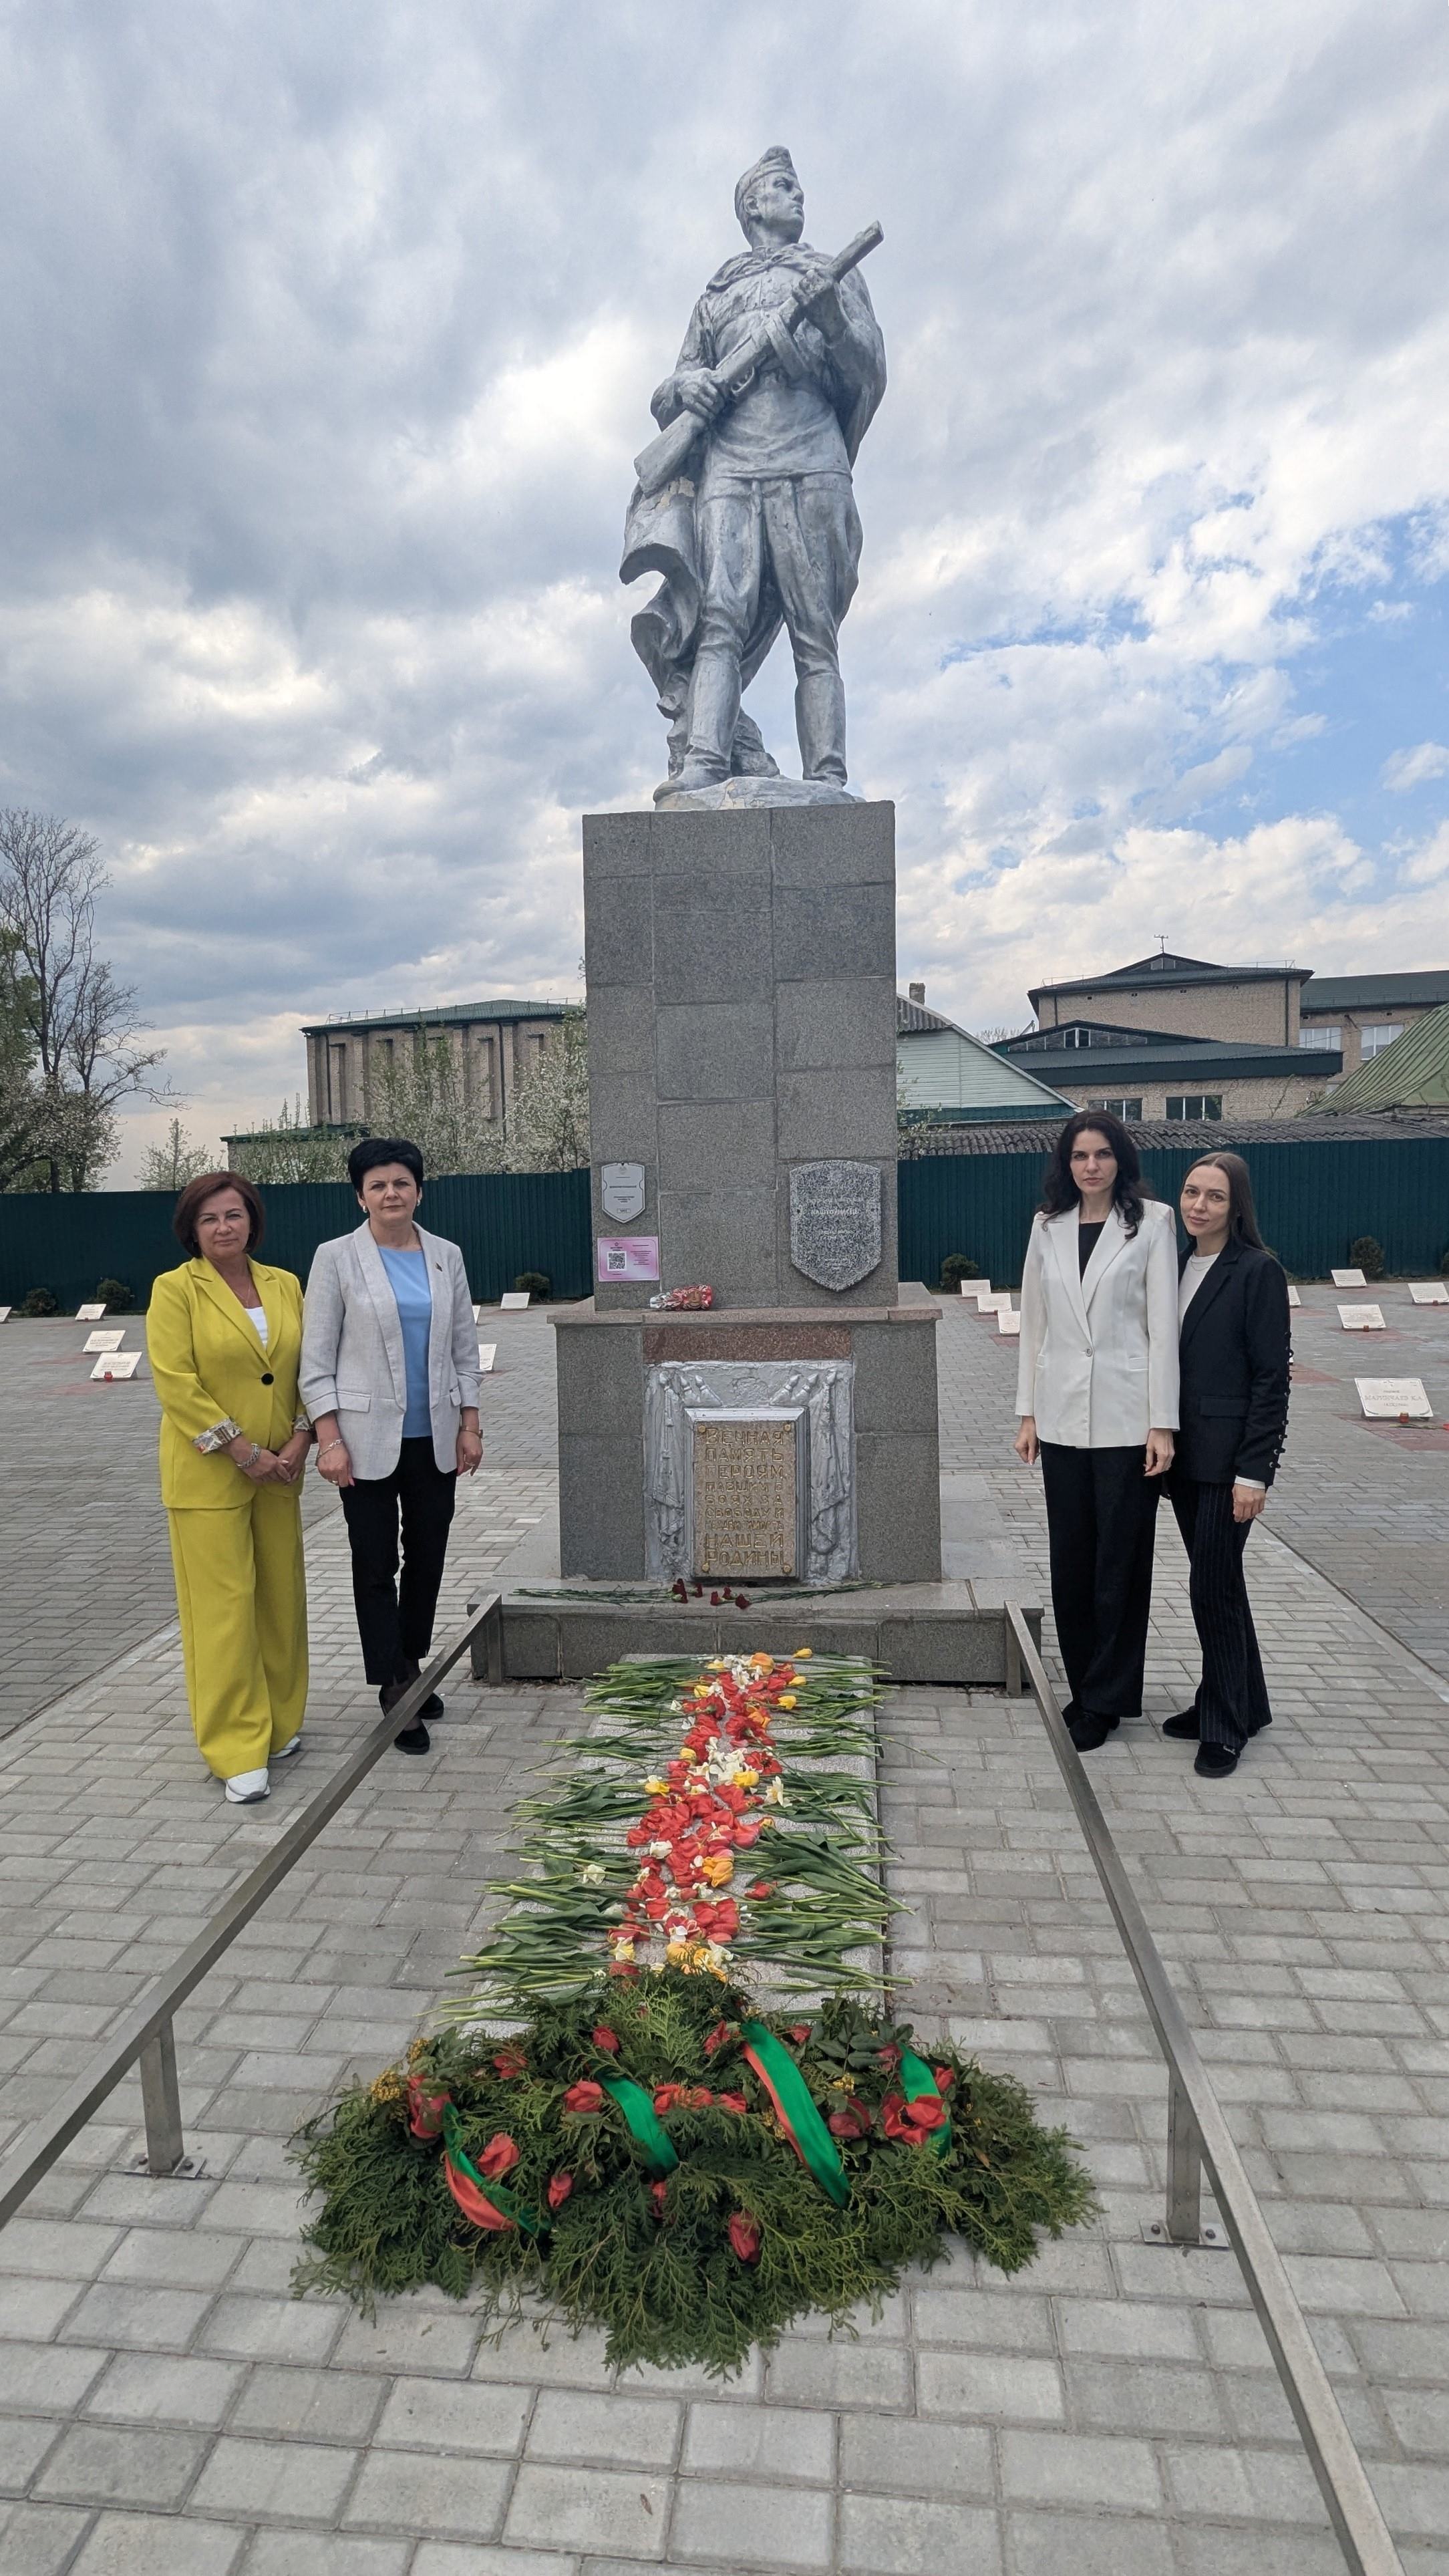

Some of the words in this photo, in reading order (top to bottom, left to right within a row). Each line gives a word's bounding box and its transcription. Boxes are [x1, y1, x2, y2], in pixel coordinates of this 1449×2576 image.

[705, 1428, 784, 1445] ВЕЧНАЯ
[705, 1448, 784, 1463] ПАМЯТЬ
[705, 1465, 784, 1479] ГЕРОЯМ
[705, 1481, 769, 1492] ПАВШИМ
[705, 1495, 752, 1506] БОЯХ
[761, 1494, 782, 1506] ЗА
[705, 1508, 771, 1518] СВОБОДУ
[775, 1508, 784, 1518] И
[705, 1532, 784, 1548] НАШЕЙ
[705, 1549, 784, 1566] РОДИНЫ
